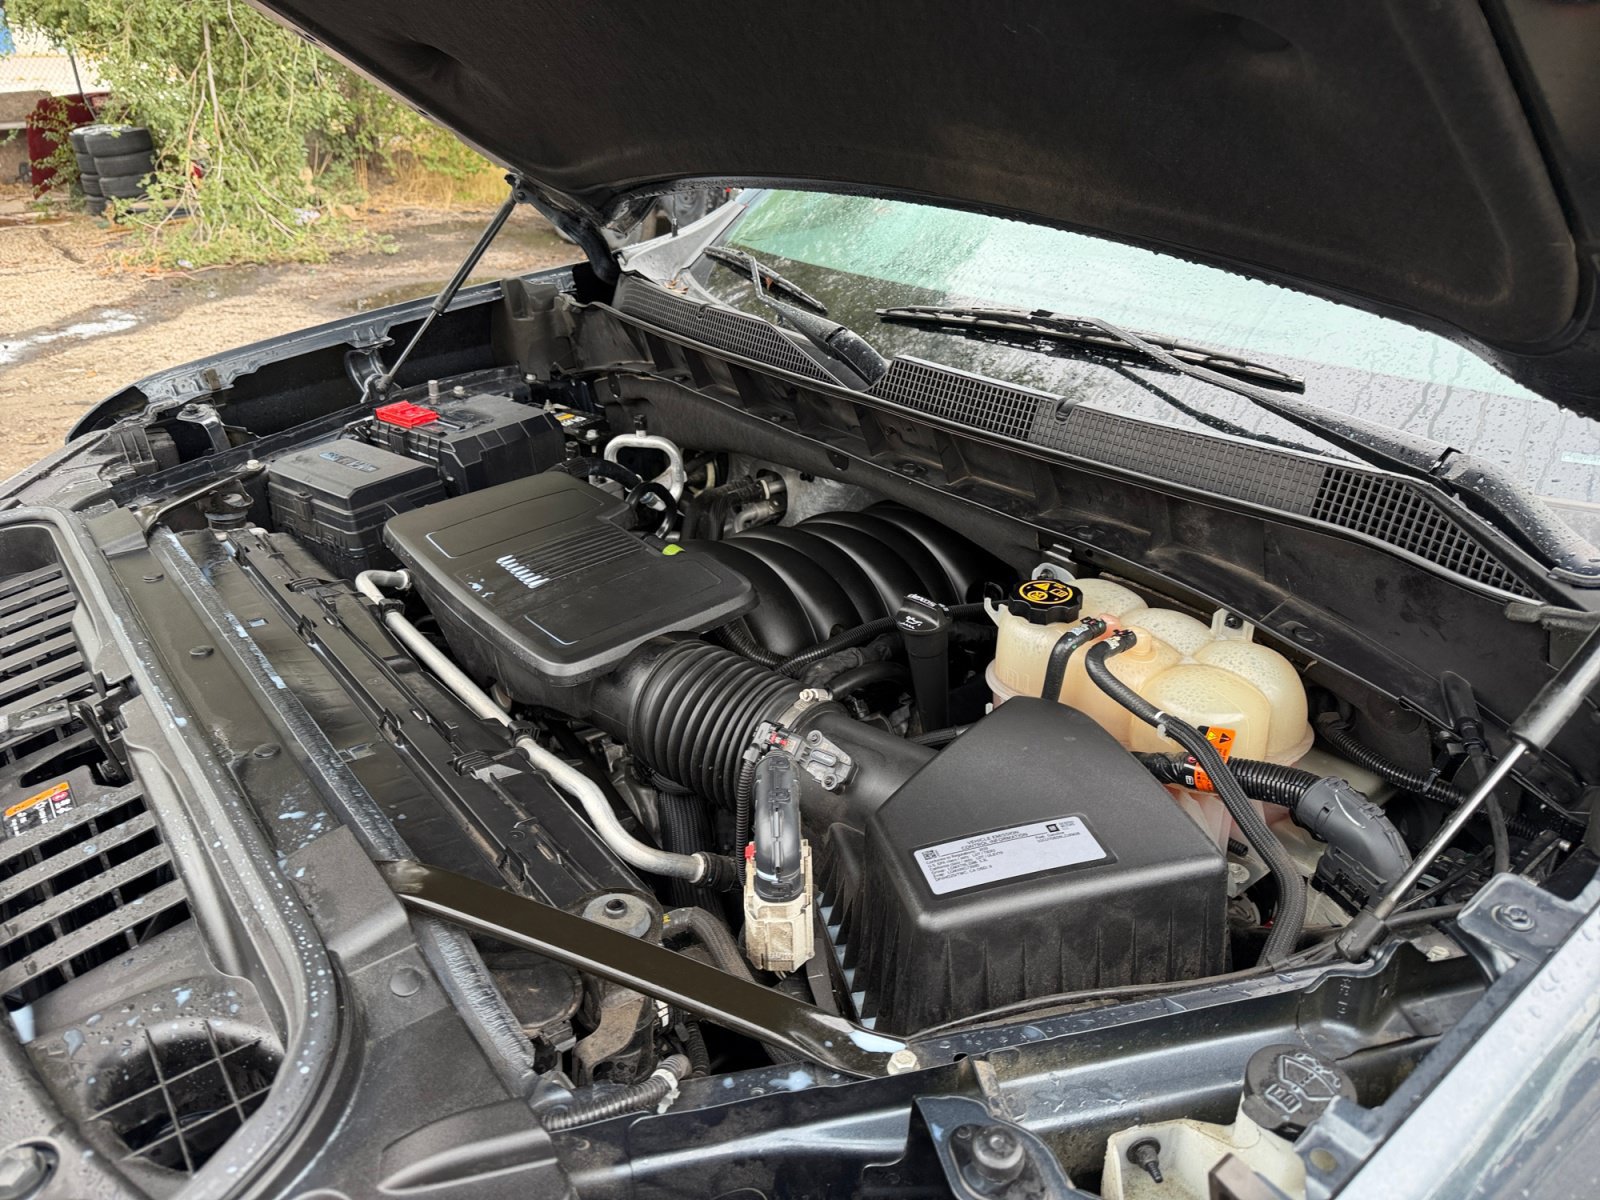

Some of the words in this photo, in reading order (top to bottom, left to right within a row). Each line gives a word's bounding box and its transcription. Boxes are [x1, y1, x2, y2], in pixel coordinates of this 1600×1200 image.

[961, 840, 988, 851] CONTROL
[989, 832, 1029, 844] INFORMATION
[967, 836, 990, 845] VEHICLE
[991, 830, 1020, 840] EMISSION
